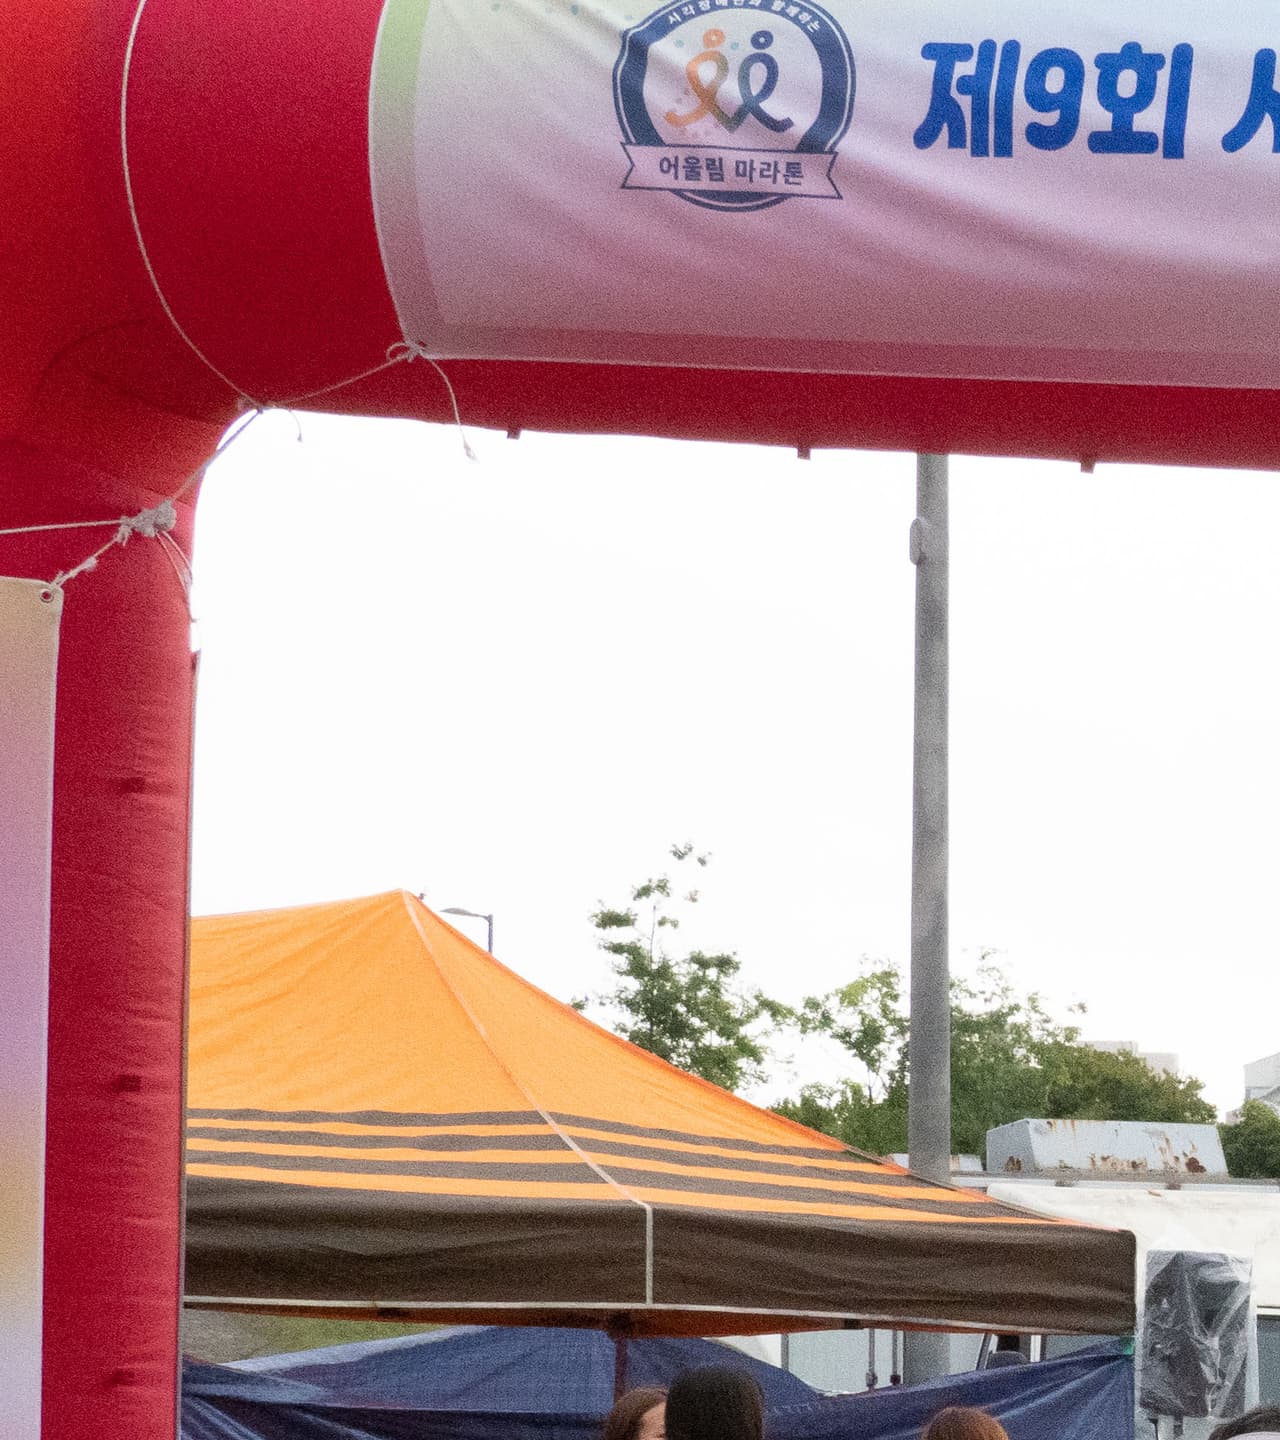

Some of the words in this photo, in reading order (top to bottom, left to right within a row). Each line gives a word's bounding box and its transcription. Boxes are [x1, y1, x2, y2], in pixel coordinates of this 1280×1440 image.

[913, 38, 1194, 160] 제9회
[659, 155, 725, 183] 어울림
[735, 159, 804, 186] 마라톤
